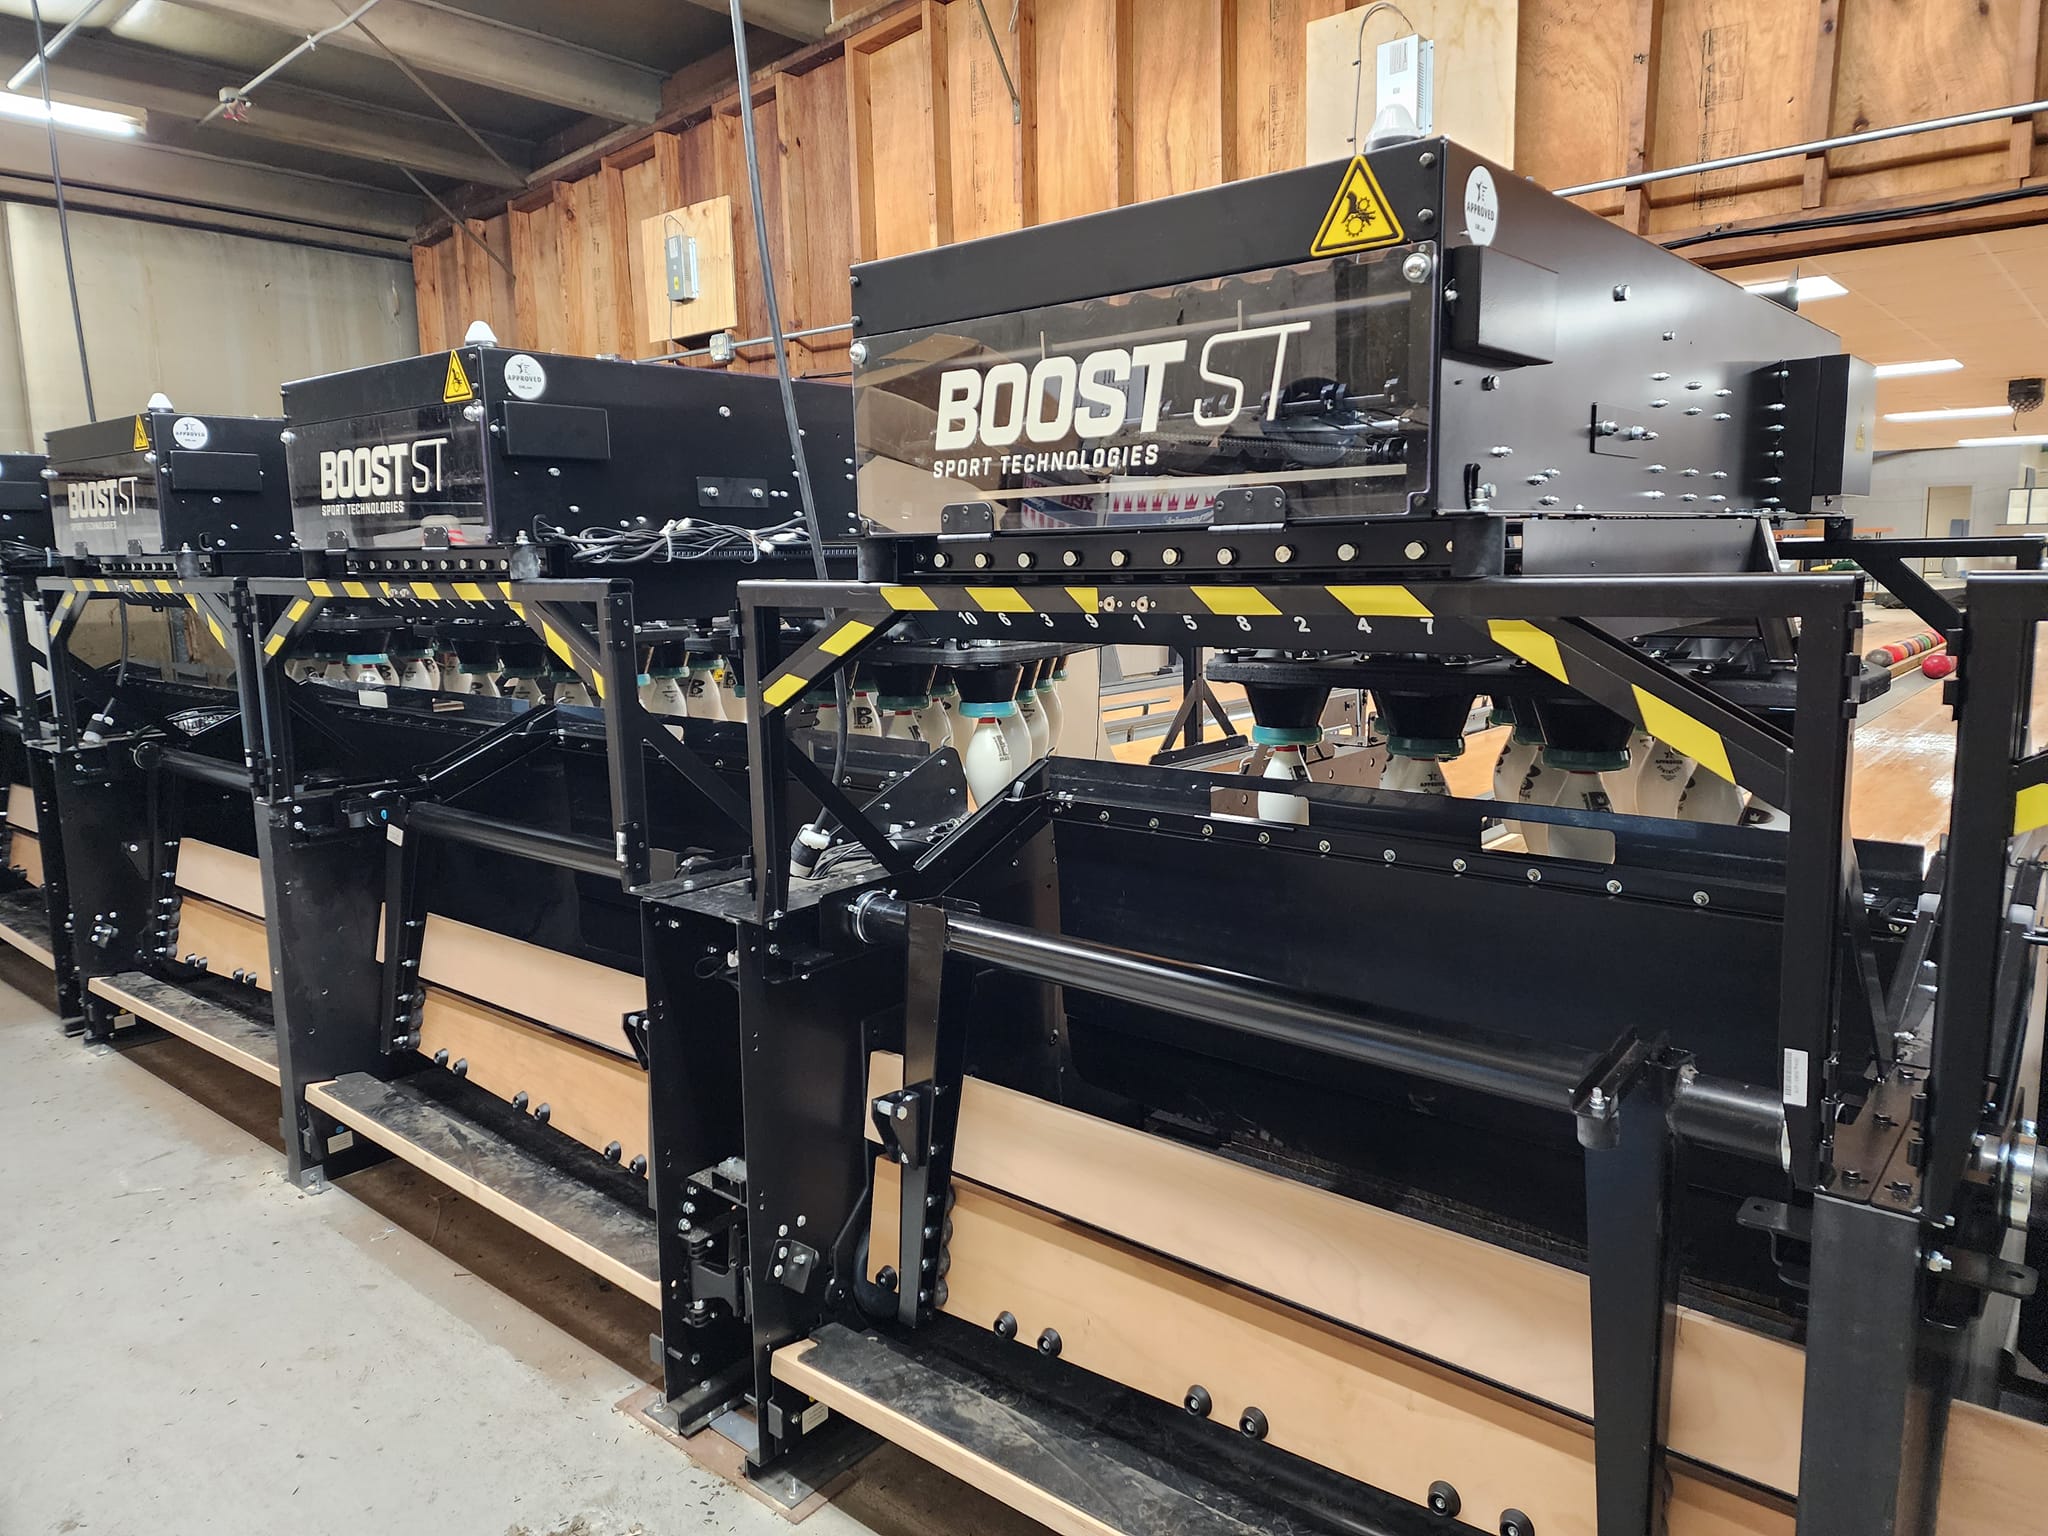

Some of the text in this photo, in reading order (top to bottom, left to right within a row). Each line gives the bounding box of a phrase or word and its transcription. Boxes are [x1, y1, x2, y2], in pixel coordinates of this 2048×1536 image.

[1466, 202, 1495, 221] APPROVED
[507, 375, 542, 383] APPROVED
[935, 321, 1311, 450] BOOST ST
[320, 438, 448, 500] BOOST ST
[933, 443, 1160, 479] SPORT TECHNOLOGIES
[67, 476, 138, 519] BOOST ST
[321, 501, 405, 516] SPORT TECHNOLOGIES
[957, 611, 1434, 635] 10 6 3 9 1 5 8 2 4 7
